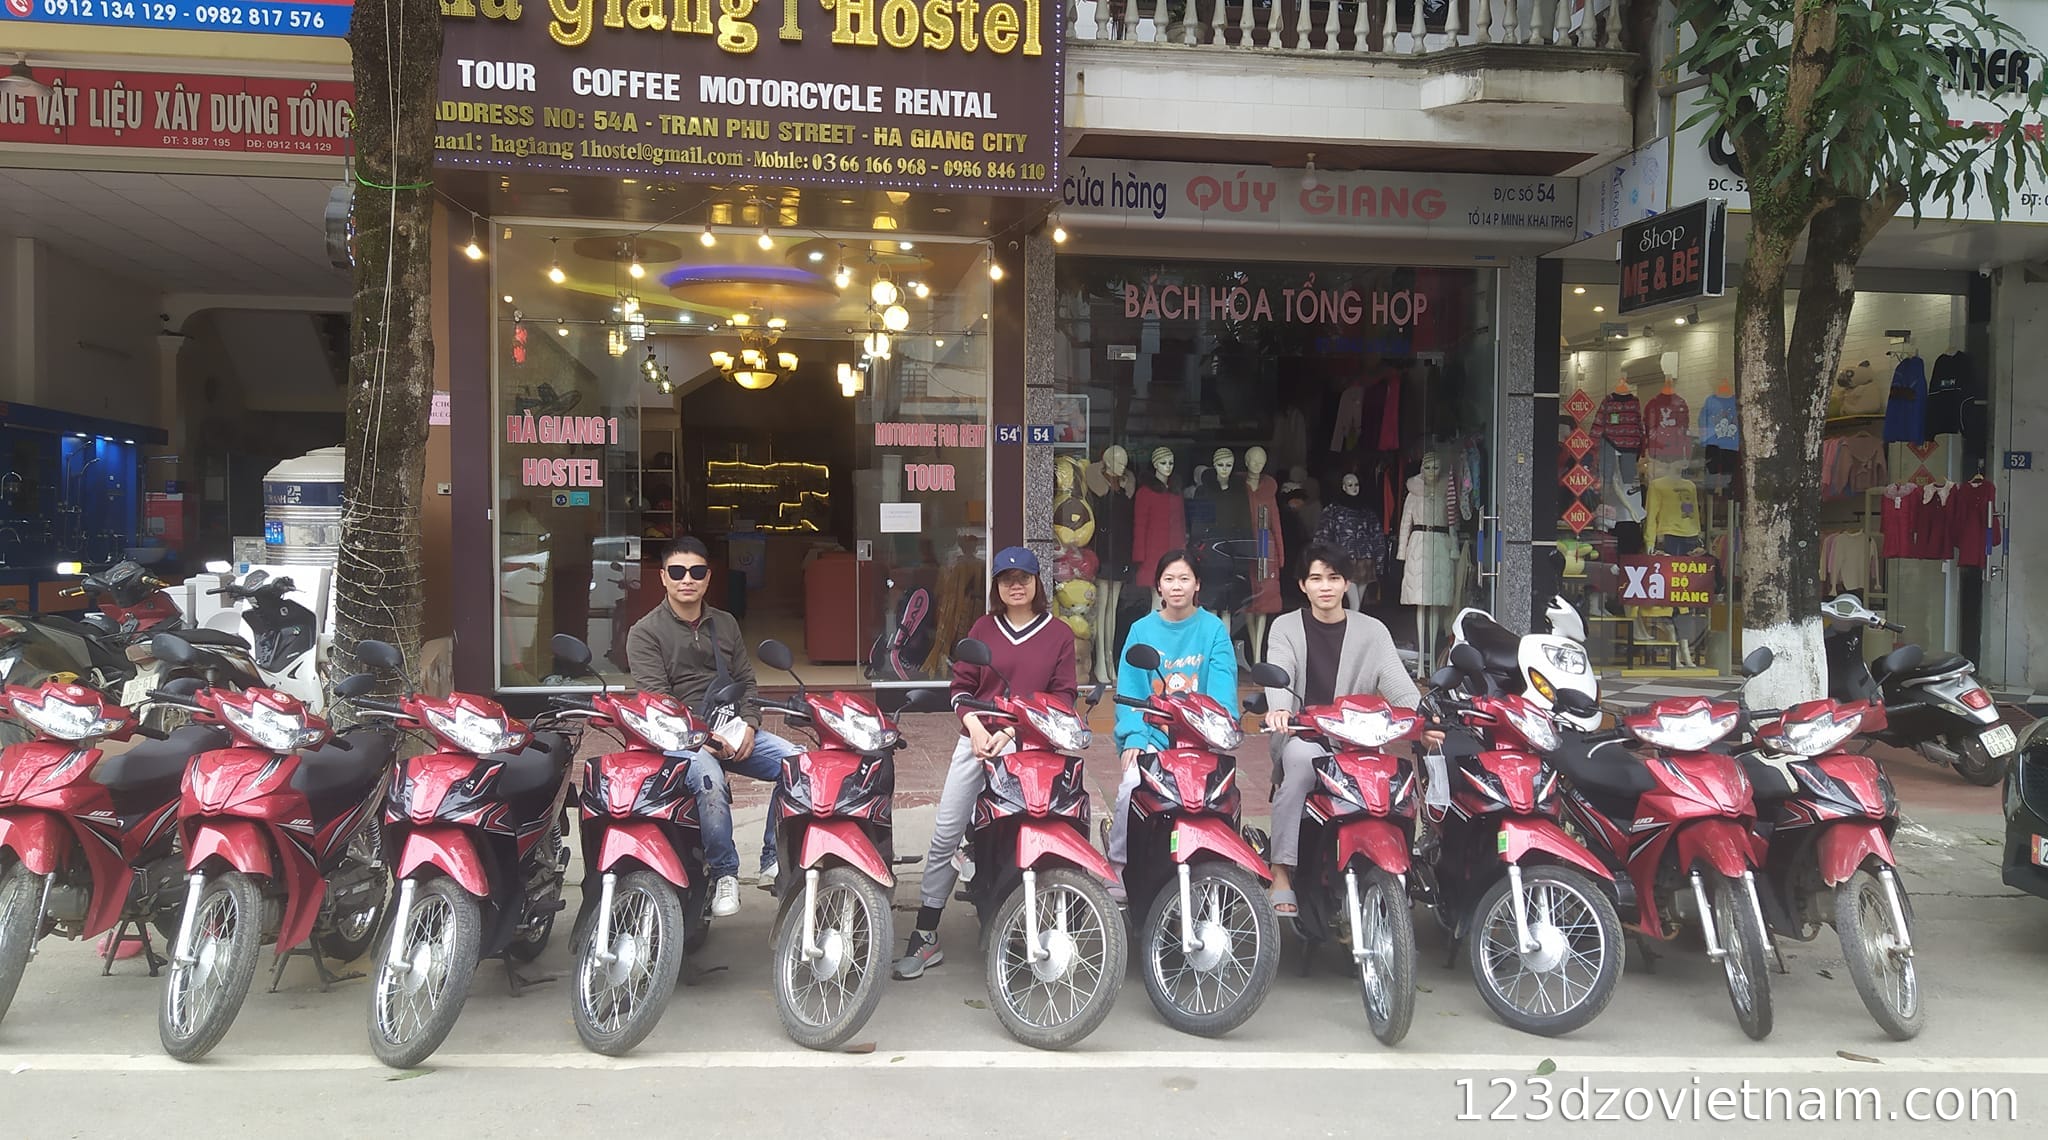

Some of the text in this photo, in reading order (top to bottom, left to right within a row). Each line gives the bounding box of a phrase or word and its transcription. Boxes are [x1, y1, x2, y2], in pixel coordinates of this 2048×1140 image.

[45, 0, 93, 17] 0912
[101, 1, 135, 19] 134
[142, 3, 176, 21] 129
[195, 6, 243, 24] 0982
[249, 8, 282, 26] 817
[290, 11, 324, 28] 576
[820, 0, 1042, 55] Hostel
[457, 59, 997, 119] TOUR COFFEE MOTORCYCLE RENTAL
[36, 78, 78, 134] VẬT
[89, 81, 142, 136] LIỆU
[154, 83, 200, 131] XÂY
[287, 82, 350, 138] TỔNG
[183, 137, 188, 145] 3
[192, 137, 209, 146] 887
[213, 138, 231, 147] 195
[543, 107, 584, 129] NO:
[594, 110, 638, 133] 54A
[659, 114, 718, 138] TRAN
[727, 118, 769, 140] PHU
[778, 121, 856, 145] STREET
[873, 127, 902, 147] HA
[910, 128, 975, 152] GIANG
[982, 132, 1028, 153] CITY
[267, 141, 290, 149] 0912
[294, 142, 311, 150] 134
[314, 143, 332, 151] 129
[490, 133, 575, 160] hagiang
[581, 140, 743, 167] 1hostel@gmail.com
[753, 151, 808, 170] Mobile:
[865, 156, 893, 174] 166
[897, 157, 926, 176] 968
[943, 159, 982, 178] 0986
[987, 161, 1016, 179] 846
[1020, 162, 1045, 180] 110
[1063, 166, 1447, 220] cửa hàng QÚY GIANG
[1494, 188, 1515, 202] Đ/C
[1537, 183, 1555, 202] 54
[1482, 213, 1491, 224] 14
[1493, 213, 1498, 225] P
[1501, 213, 1524, 226] MINH
[1528, 215, 1548, 227] KHAI
[1551, 215, 1573, 228] TPHG
[1639, 225, 1685, 251] Shop
[1623, 237, 1699, 302] MẸ & BÉ
[1125, 272, 1428, 333] BÁCH HÓA TỔNG HỢP
[507, 409, 618, 445] HÀ GIANG 1
[875, 422, 986, 448] MOTORBIKE FOR RENT
[1033, 427, 1049, 442] 54
[522, 458, 604, 487] HOSTEL
[2011, 454, 2026, 467] 52
[905, 464, 955, 491] TOUR
[1623, 563, 1665, 599] Xả
[1671, 562, 1707, 573] TOÀN
[1670, 589, 1709, 602] HÀNG
[1671, 577, 1689, 588] BỘ
